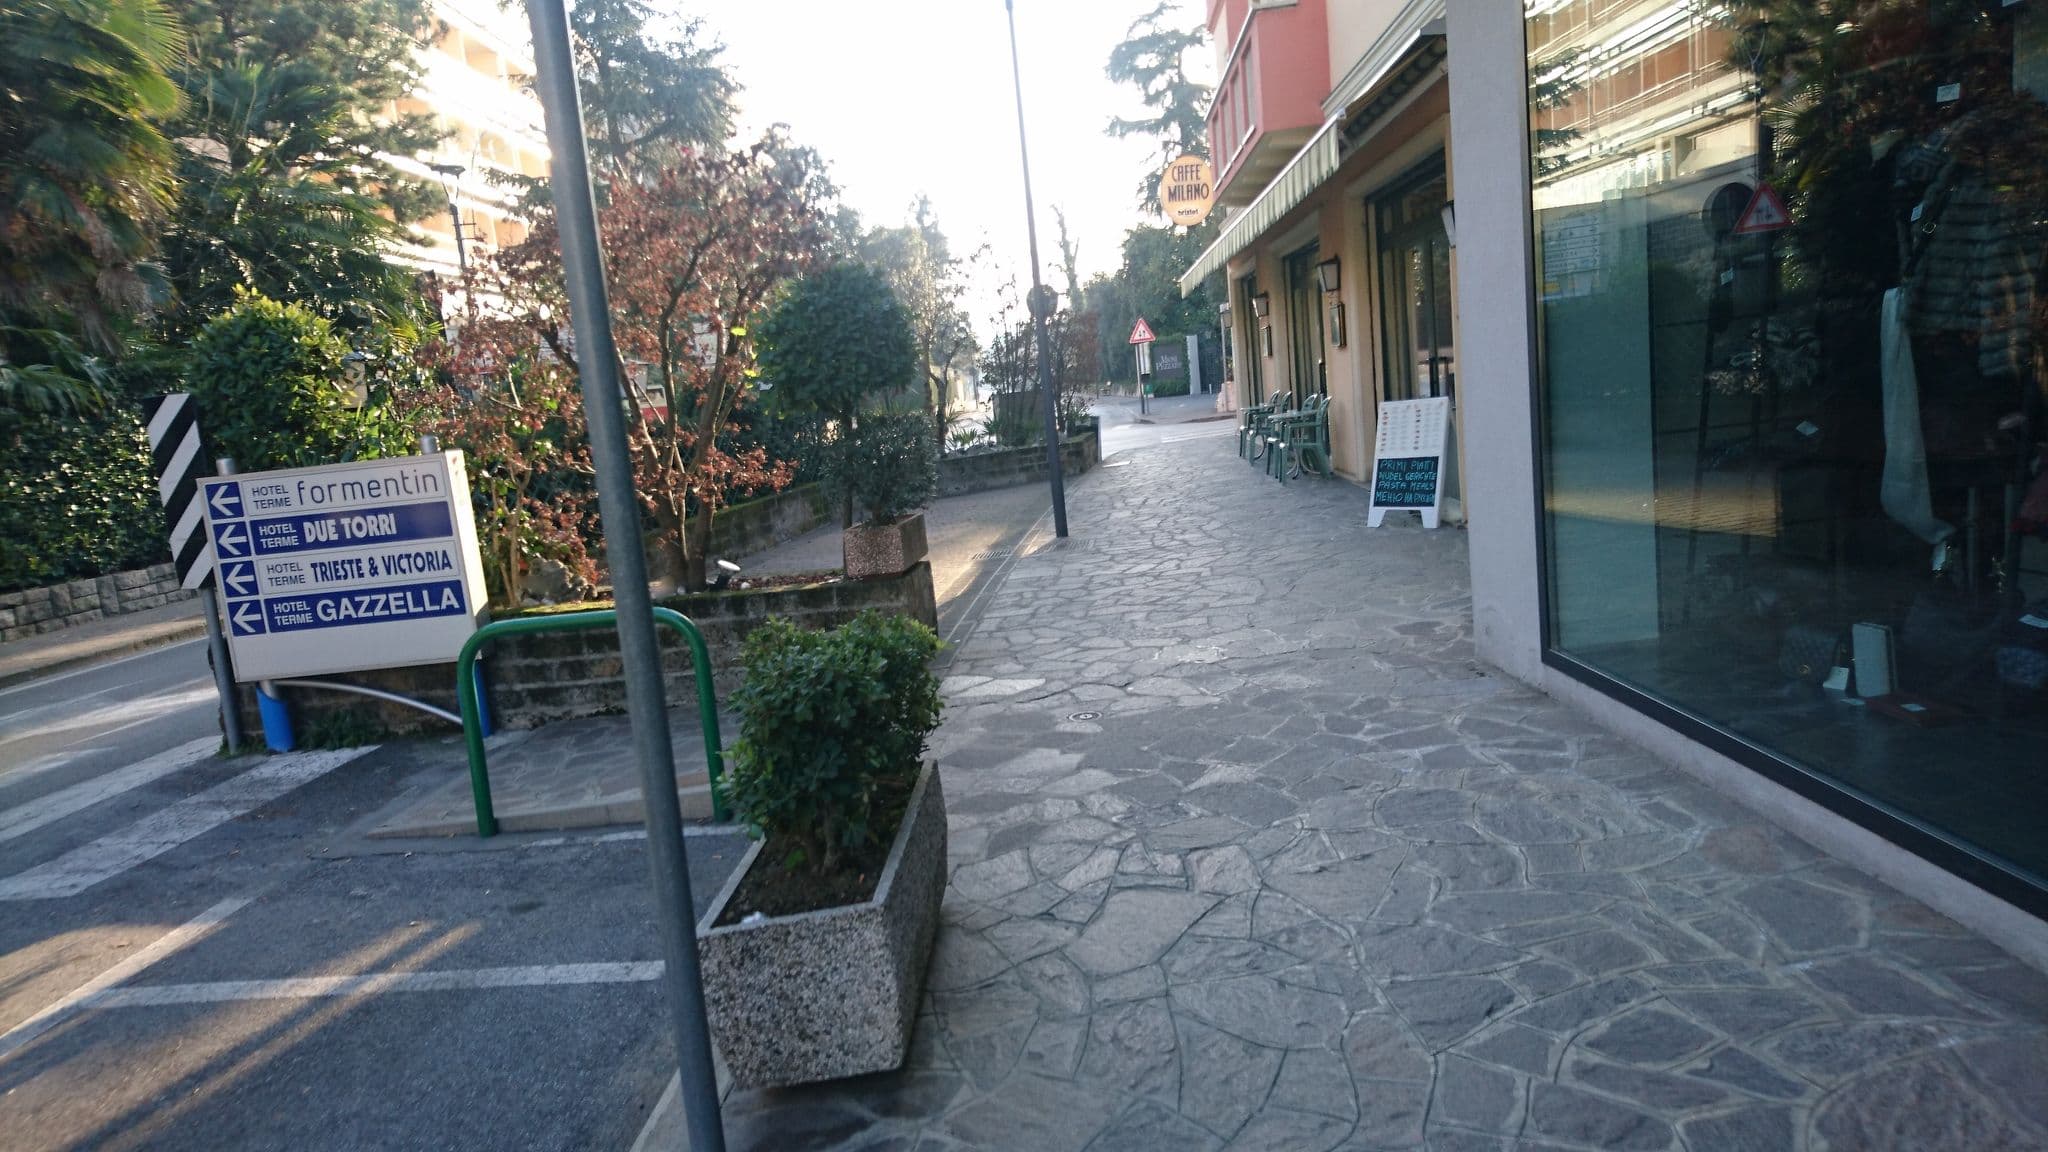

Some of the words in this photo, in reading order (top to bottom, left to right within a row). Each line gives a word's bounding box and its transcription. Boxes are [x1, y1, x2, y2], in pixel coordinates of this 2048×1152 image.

[1168, 183, 1209, 202] MILANO
[252, 485, 289, 497] HOTEL
[297, 470, 438, 506] formentin
[1378, 481, 1406, 490] PASTA
[254, 497, 292, 510] TERME
[259, 523, 297, 536] HOTEL
[304, 519, 338, 544] DUE
[341, 513, 397, 538] TORRI
[260, 534, 300, 549] TERME
[267, 562, 304, 575] HOTEL
[311, 557, 365, 583] TRIESTE
[369, 556, 379, 577] &
[382, 549, 453, 575] VICTORIA
[268, 574, 306, 587] TERME
[273, 601, 311, 613] HOTEL
[316, 587, 460, 622] GAZZELLA
[275, 613, 314, 626] TERME
